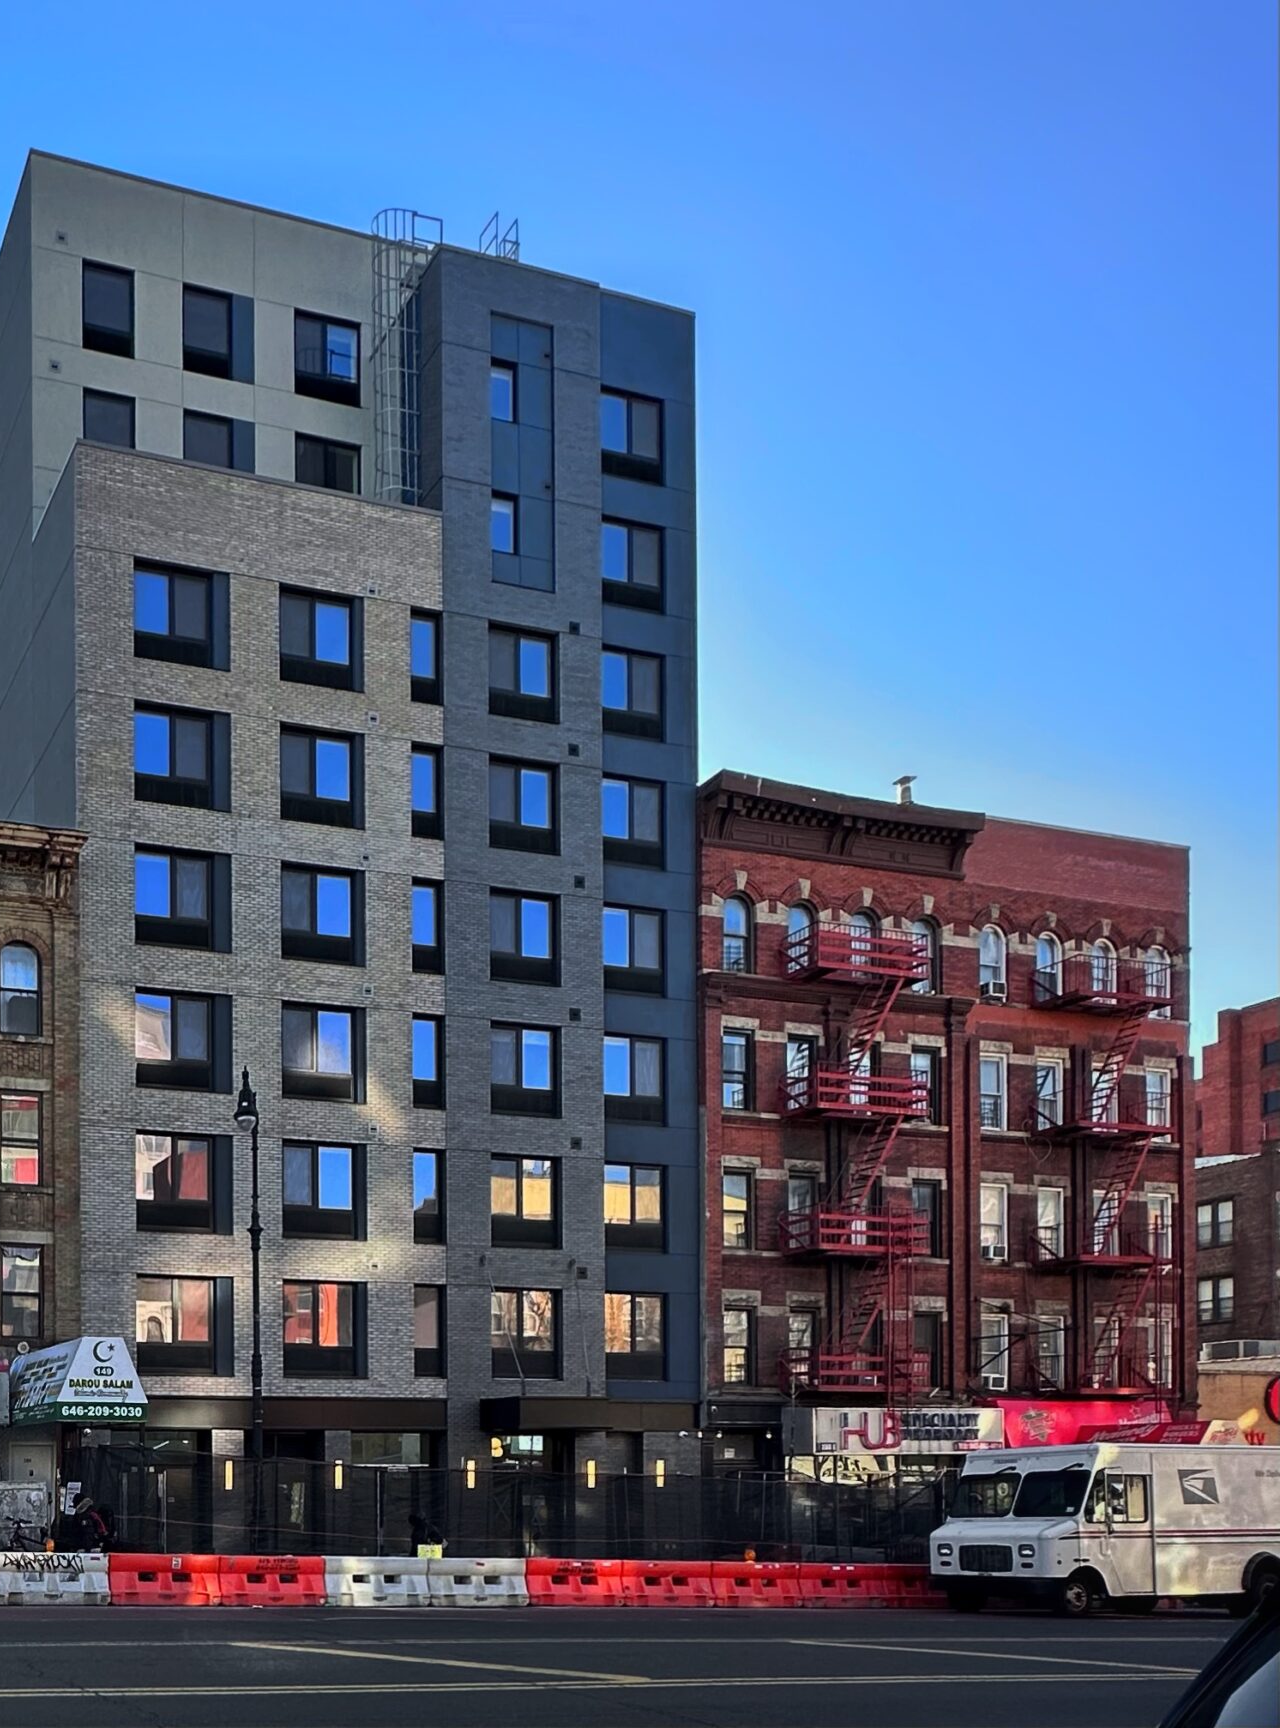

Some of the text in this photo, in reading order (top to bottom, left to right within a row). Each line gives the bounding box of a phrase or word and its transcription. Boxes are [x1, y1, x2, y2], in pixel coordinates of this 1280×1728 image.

[69, 1379, 133, 1389] DAROU SALAM
[61, 1405, 143, 1417] 646-209-3030
[839, 1411, 902, 1451] HUB
